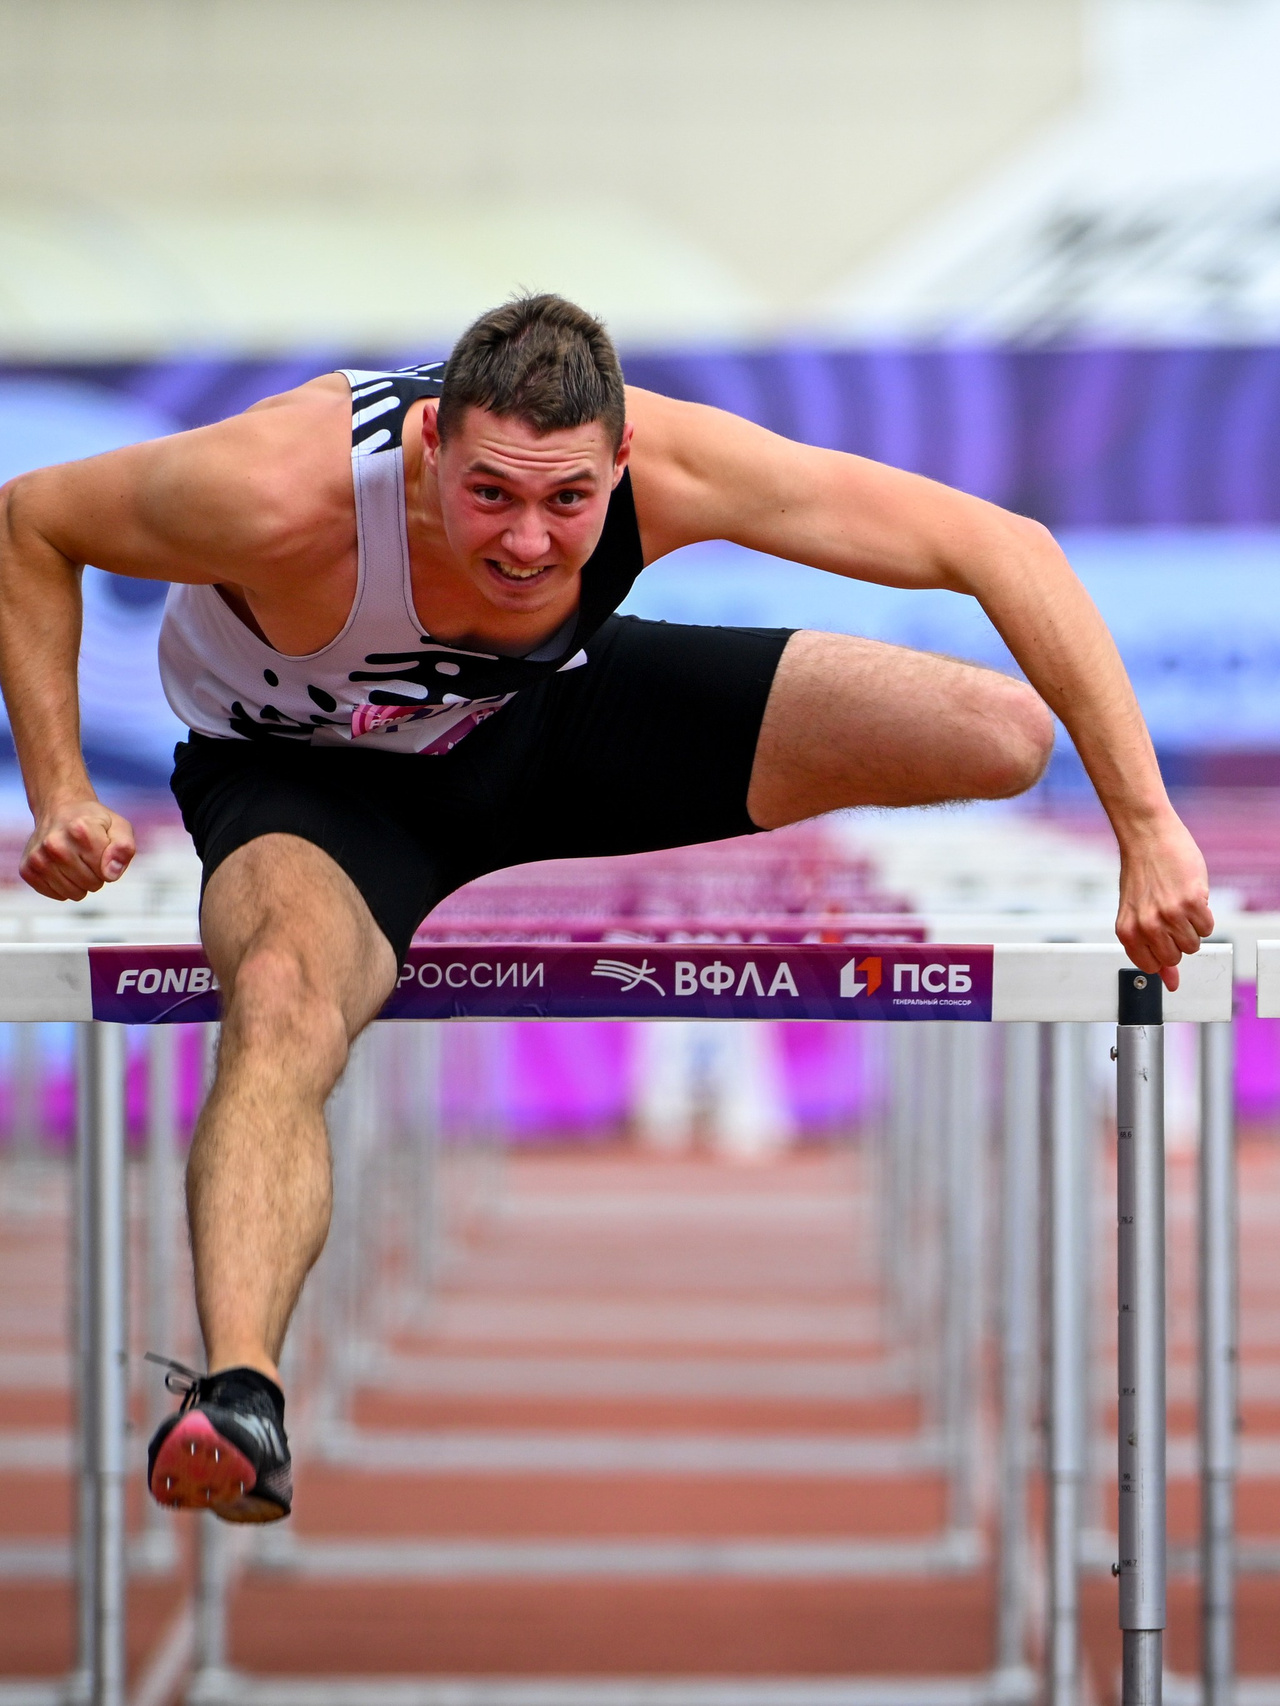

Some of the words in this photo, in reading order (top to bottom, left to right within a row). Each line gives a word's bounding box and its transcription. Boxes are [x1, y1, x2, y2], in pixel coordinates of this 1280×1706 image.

[116, 967, 218, 995] FONB
[396, 962, 544, 988] РОССИИ
[675, 960, 799, 997] ВФЛА
[893, 963, 973, 993] ПСБ
[893, 998, 938, 1006] ГЕНЕРАЛЬНЫЙ
